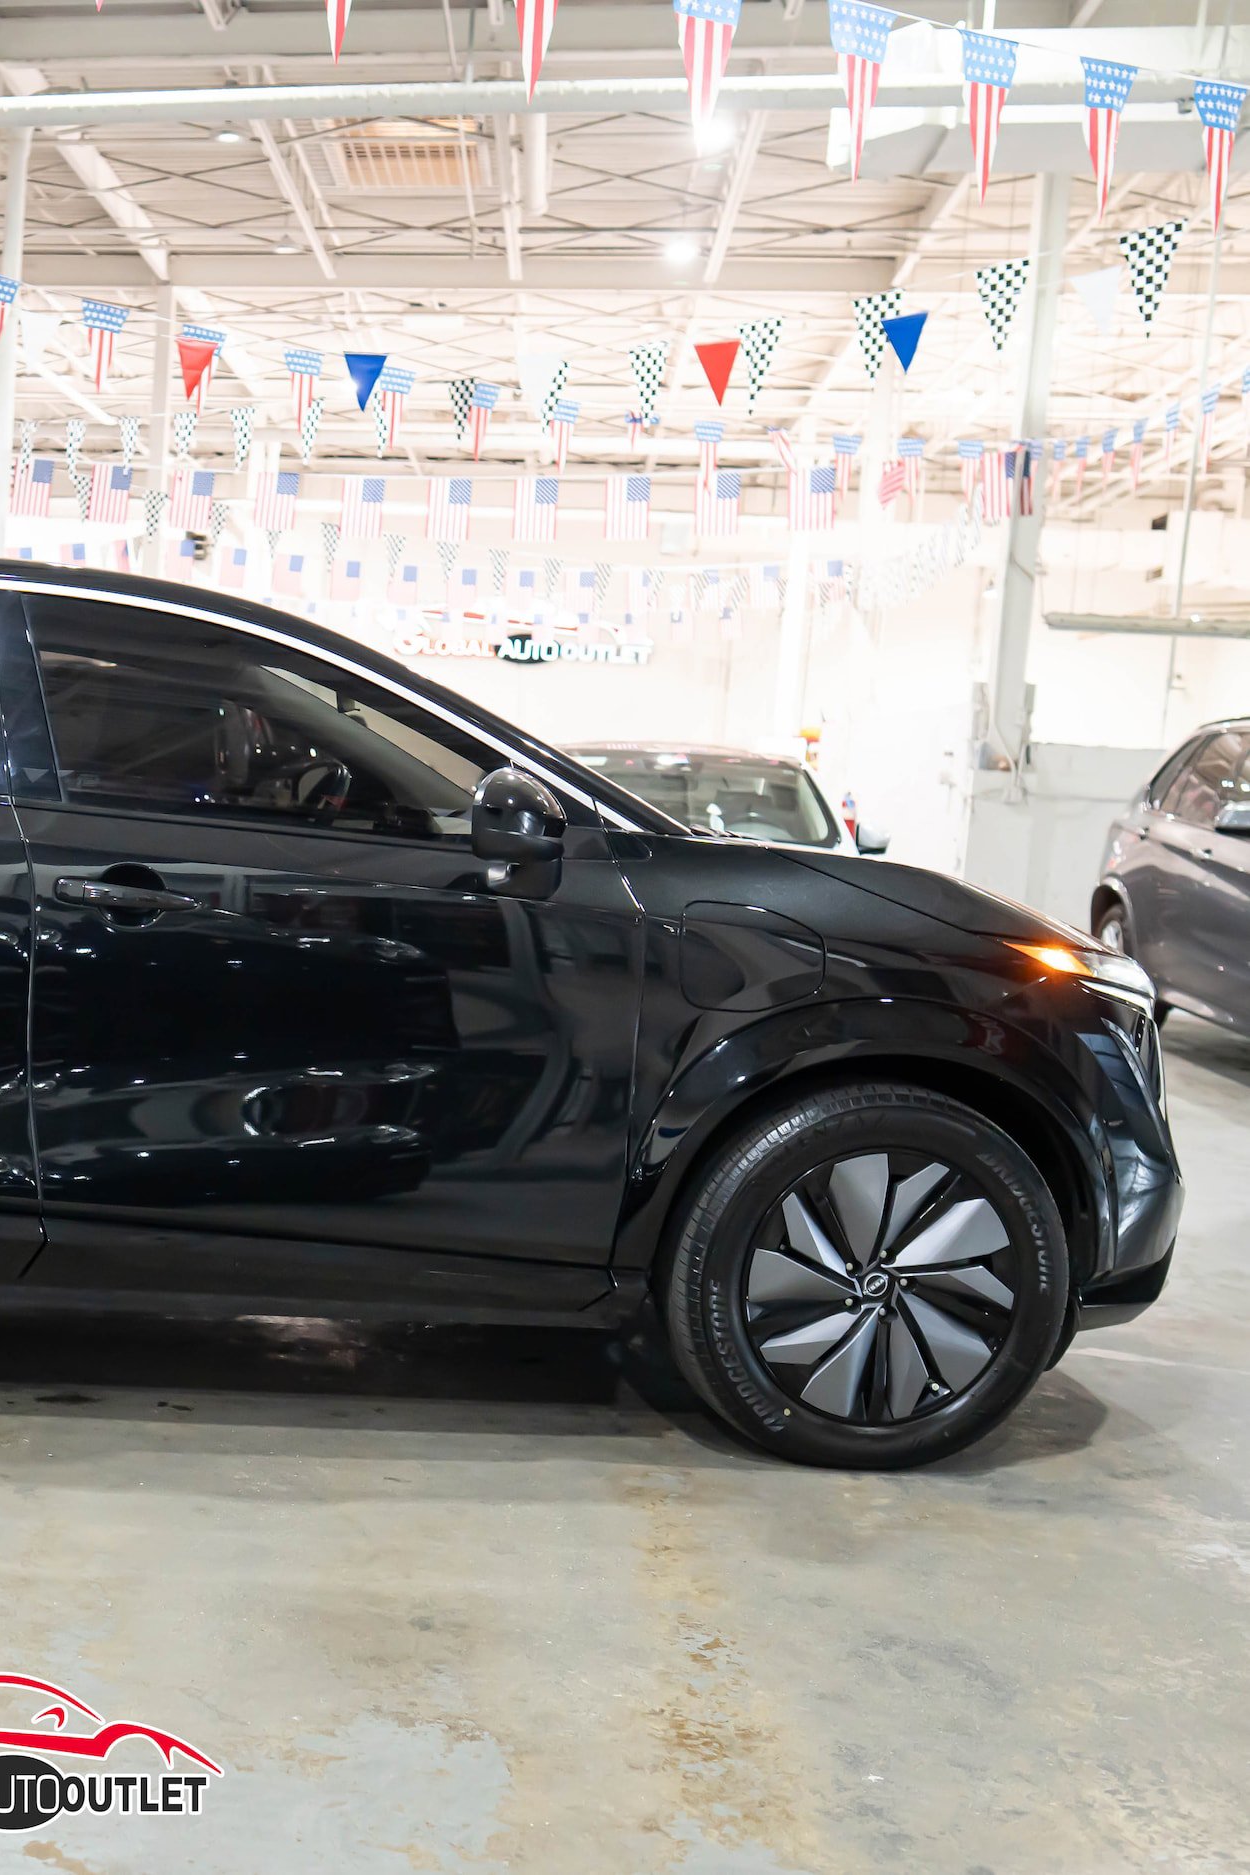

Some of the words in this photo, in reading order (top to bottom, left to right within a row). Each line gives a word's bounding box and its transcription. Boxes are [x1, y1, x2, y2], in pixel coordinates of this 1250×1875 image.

[393, 632, 496, 658] GLOBAL
[497, 638, 561, 662] AUTO
[560, 643, 654, 664] OUTLET
[709, 1279, 787, 1433] BRIDGESTONE
